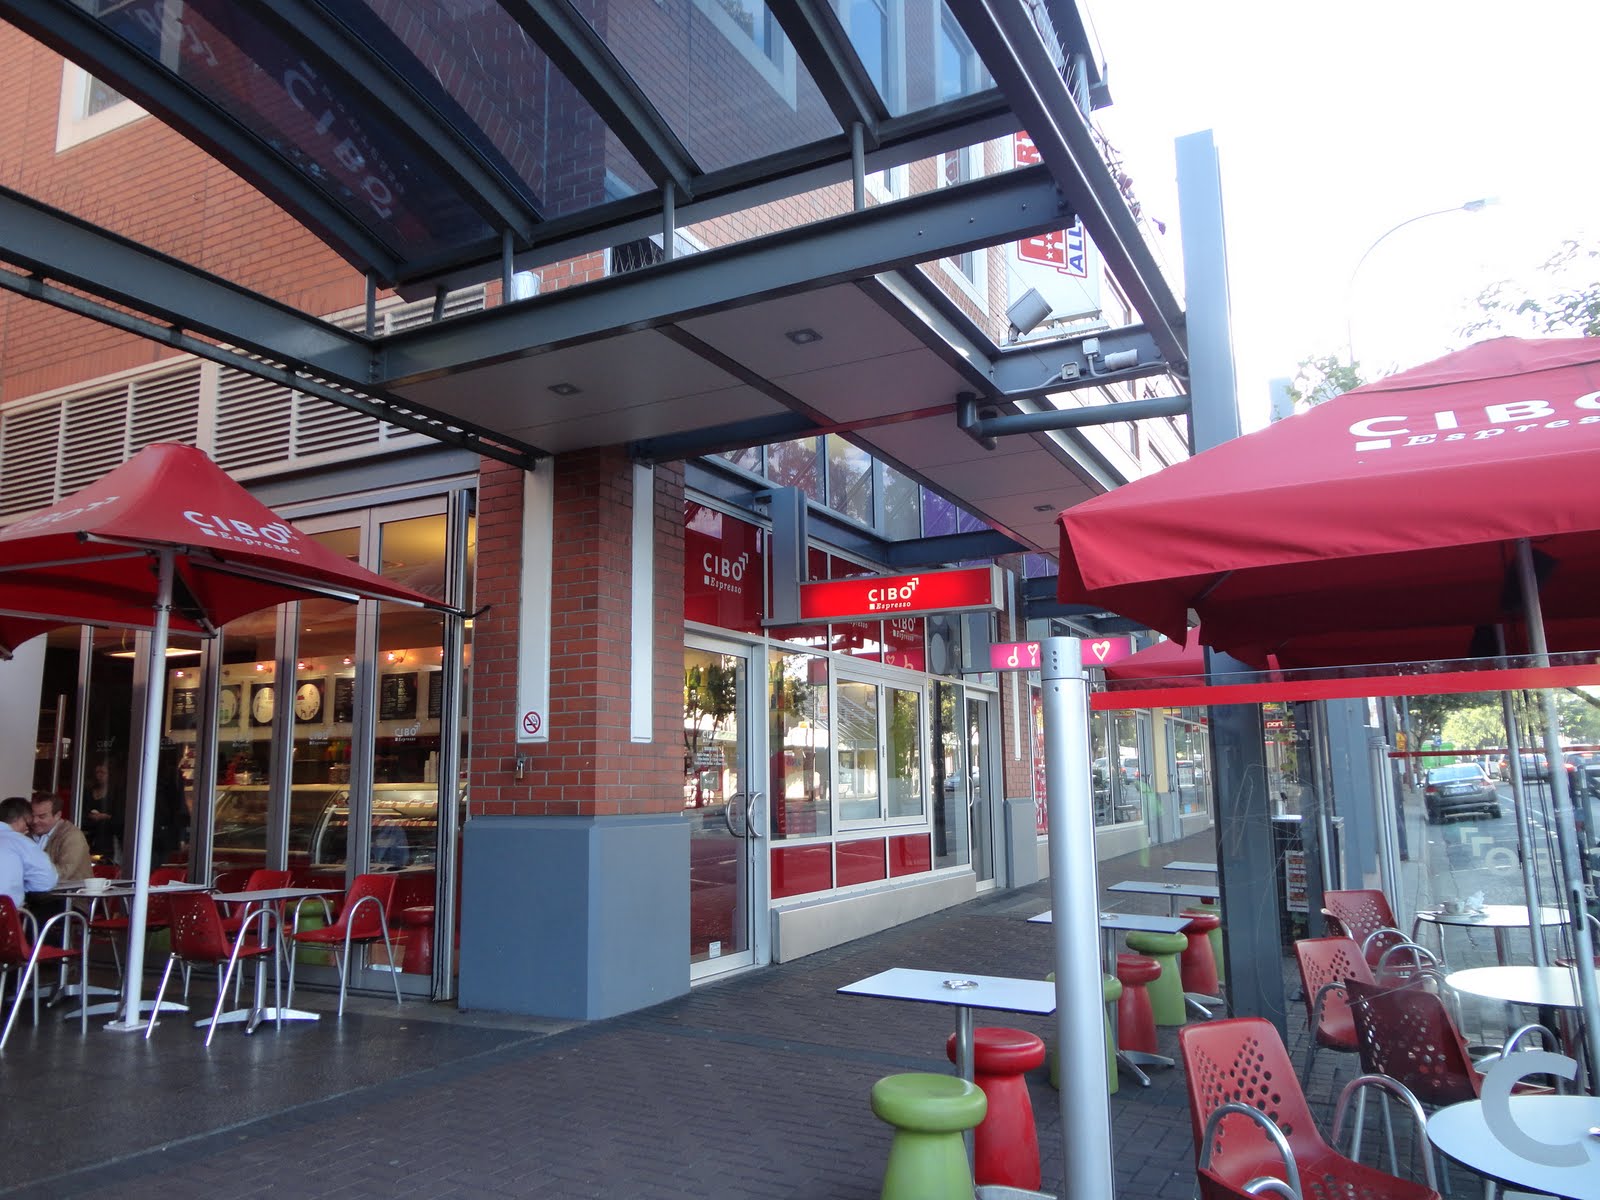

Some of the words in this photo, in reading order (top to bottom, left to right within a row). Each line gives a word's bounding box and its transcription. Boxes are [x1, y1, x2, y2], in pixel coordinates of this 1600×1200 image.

[183, 511, 289, 544] CIBO
[218, 531, 300, 554] Espresso
[703, 552, 743, 581] CIBO
[710, 577, 742, 594] Espresso
[868, 586, 912, 602] CIBO
[876, 602, 912, 610] Espresso
[395, 727, 416, 737] CIBO
